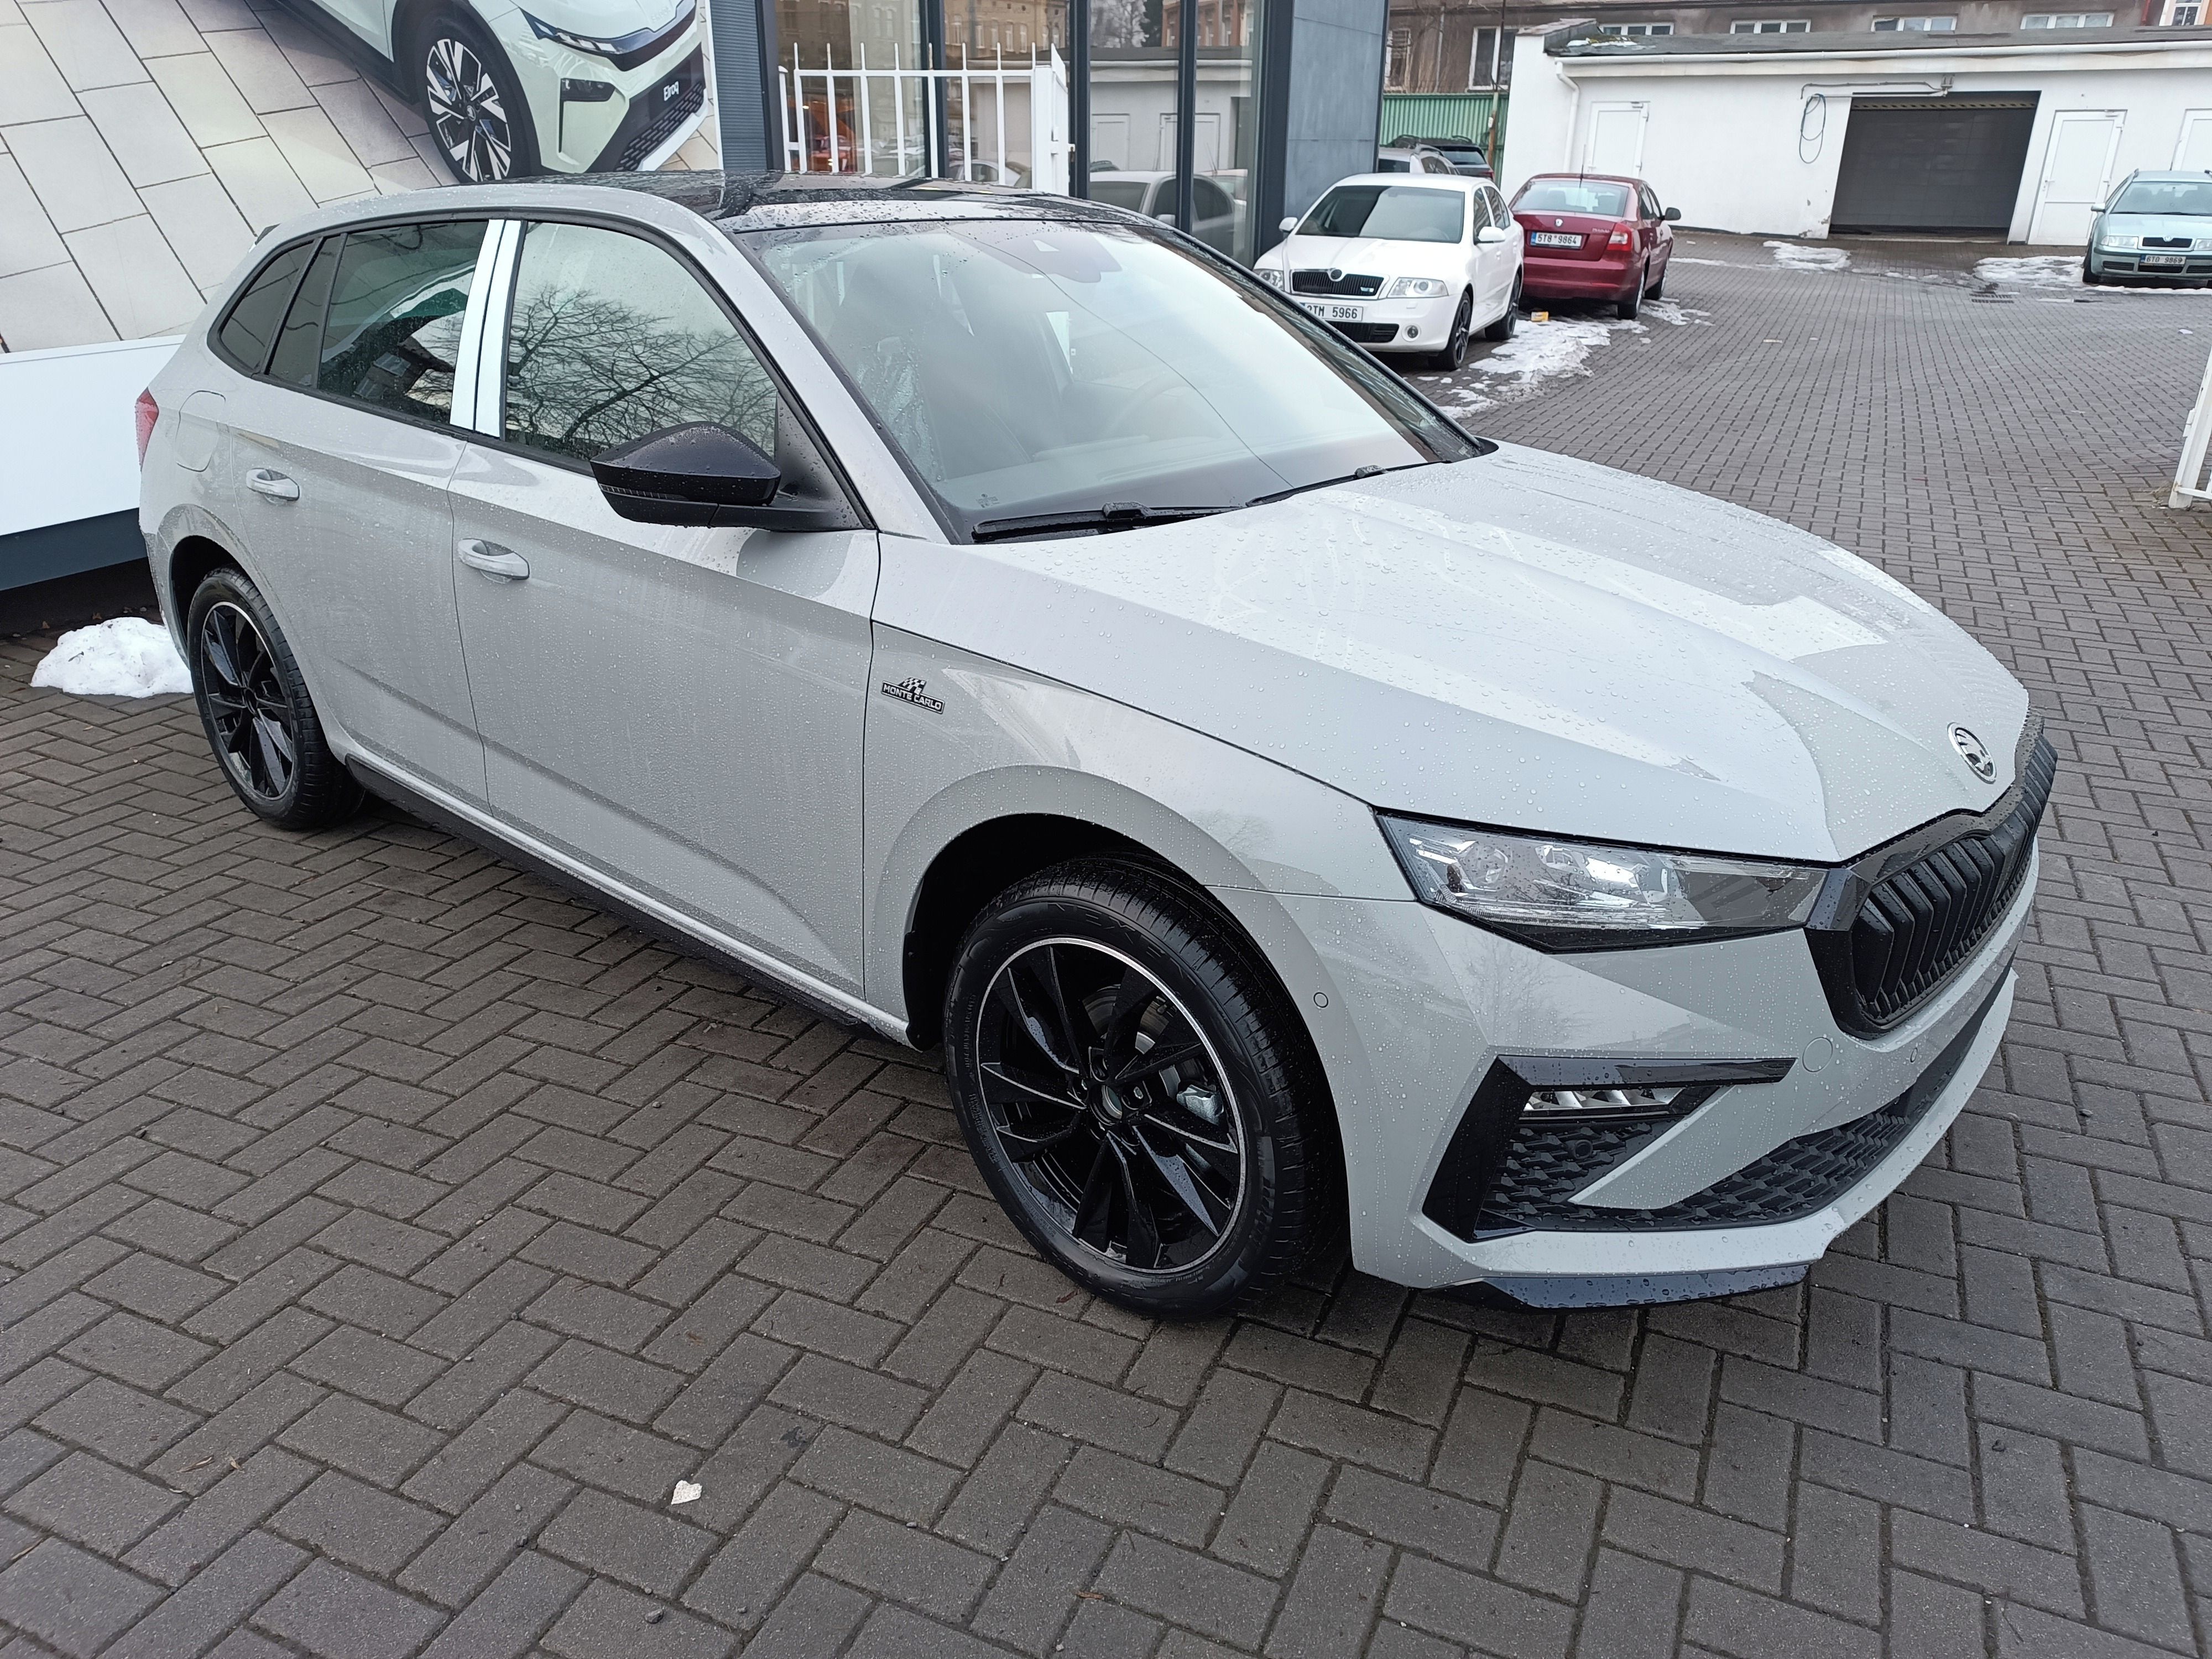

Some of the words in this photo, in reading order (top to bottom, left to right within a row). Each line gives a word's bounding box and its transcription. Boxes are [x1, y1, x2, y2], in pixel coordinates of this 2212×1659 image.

[664, 81, 679, 101] Elroq
[1537, 234, 1552, 243] 5T8
[1558, 236, 1577, 244] 9864
[1332, 306, 1358, 319] 5966
[883, 684, 912, 701] MONTE
[914, 694, 942, 710] CARLO
